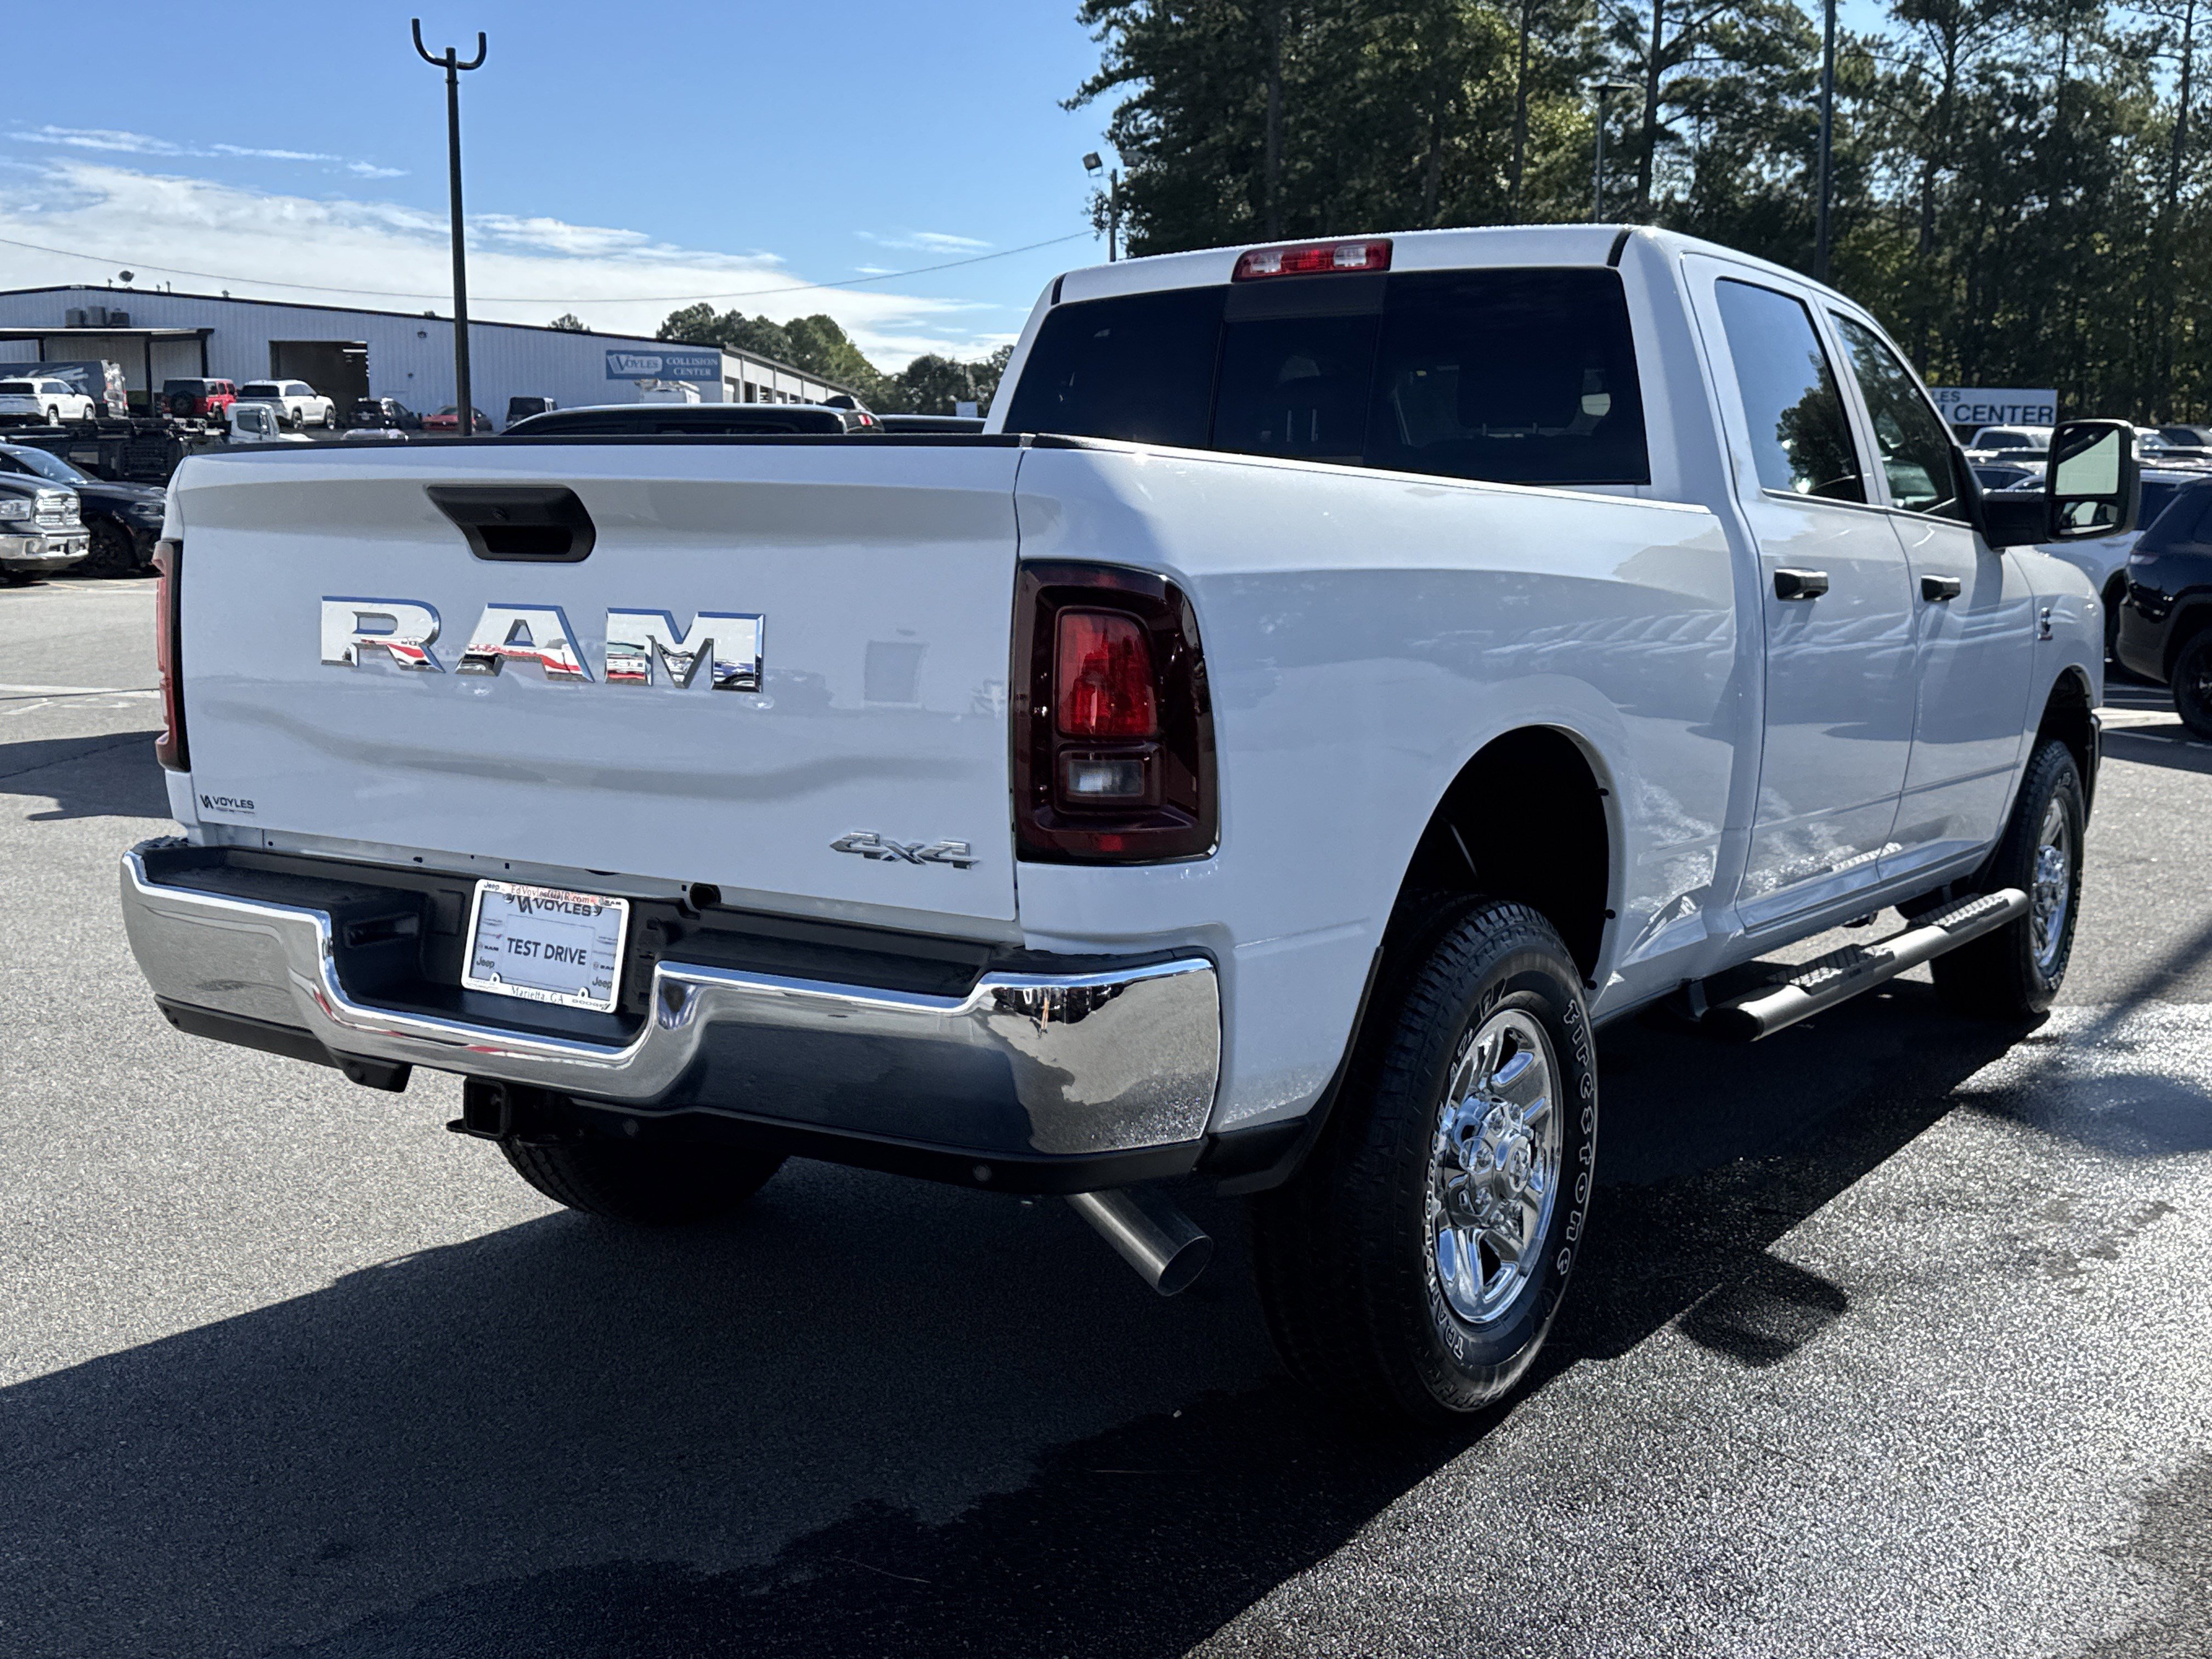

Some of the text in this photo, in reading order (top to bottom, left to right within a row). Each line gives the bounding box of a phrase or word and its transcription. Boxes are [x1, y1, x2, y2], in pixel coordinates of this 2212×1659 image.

[665, 357, 719, 366] COLLISION
[673, 368, 712, 376] CENTER
[1954, 404, 2054, 423] CENTER
[321, 595, 765, 693] RAM
[212, 796, 254, 809] VOYLES
[532, 898, 592, 917] VOYLES
[507, 937, 541, 958] TEST
[544, 944, 587, 966] DRIVE
[476, 956, 495, 969] Jeep
[592, 976, 613, 990] Jeep
[550, 992, 563, 1004] GA
